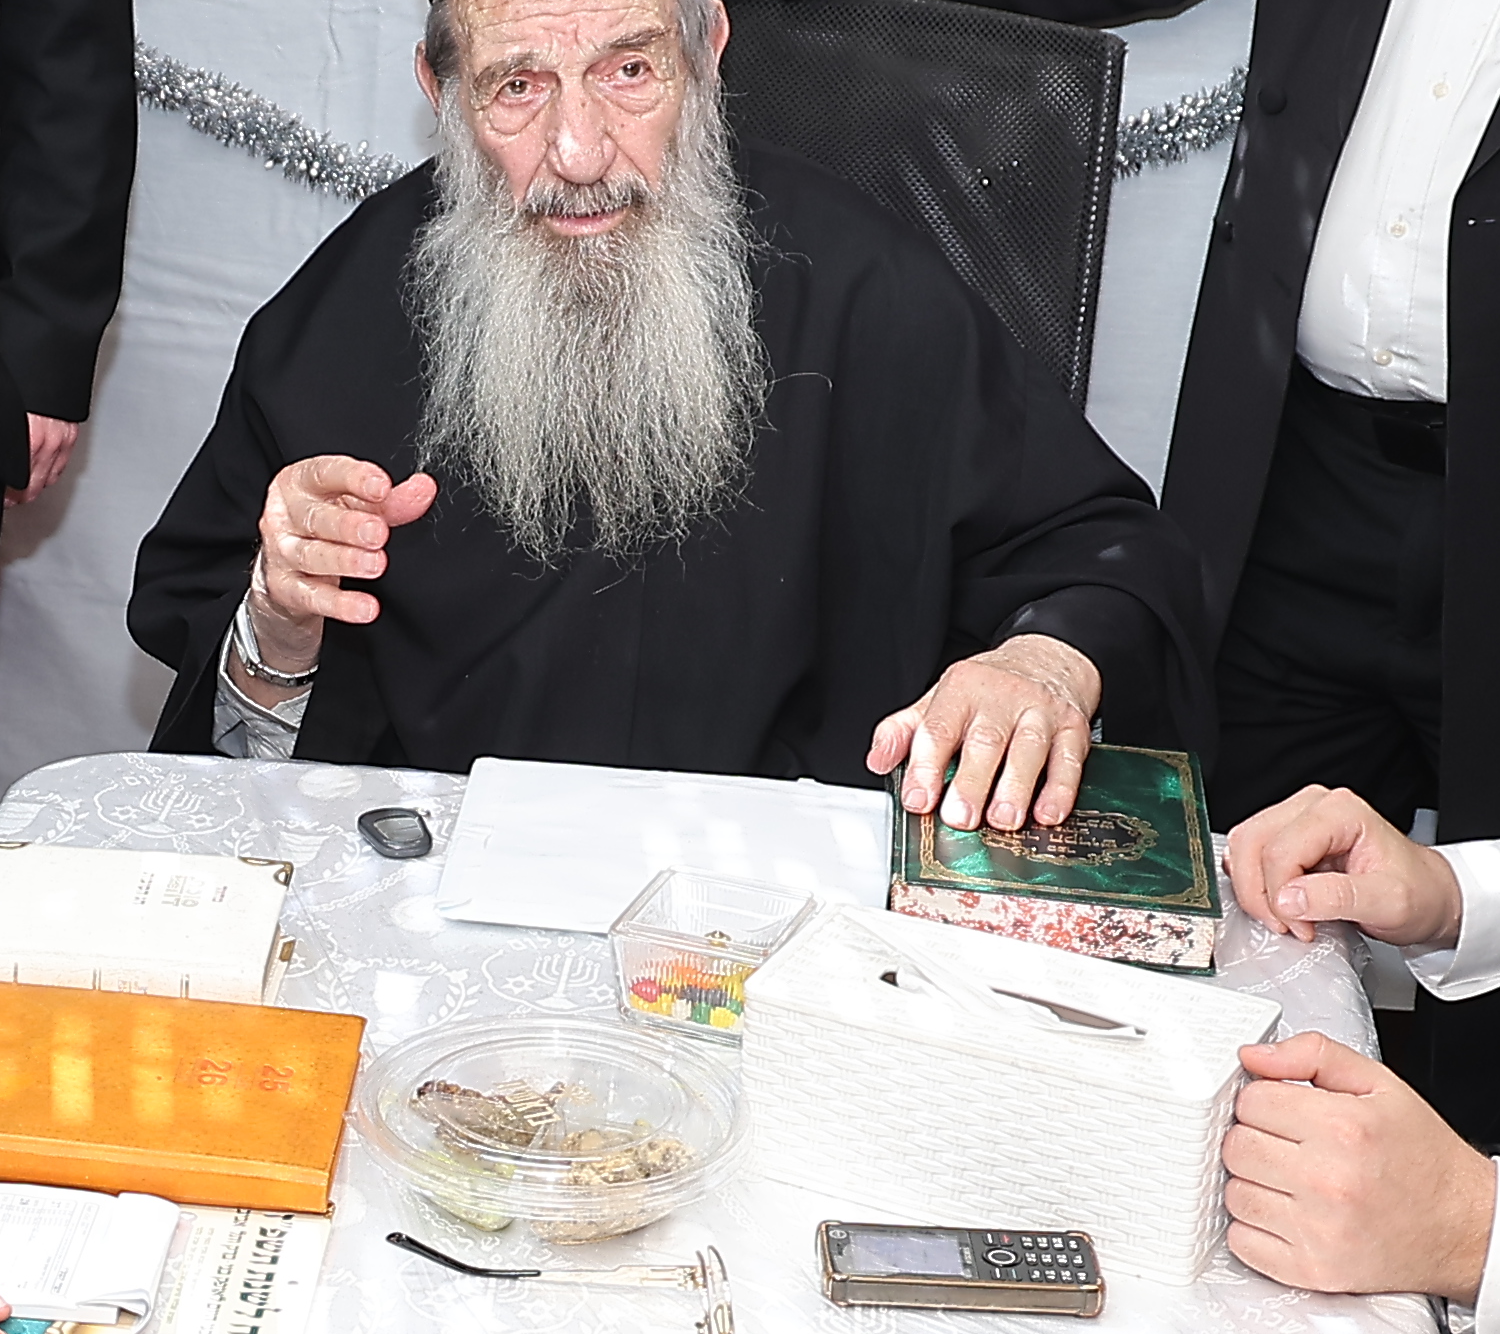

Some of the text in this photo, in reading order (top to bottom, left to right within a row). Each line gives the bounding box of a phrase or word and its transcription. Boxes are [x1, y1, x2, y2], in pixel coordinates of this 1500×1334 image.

[196, 1058, 233, 1086] 26
[258, 1064, 296, 1093] 25
[233, 1268, 282, 1320] לשנת
